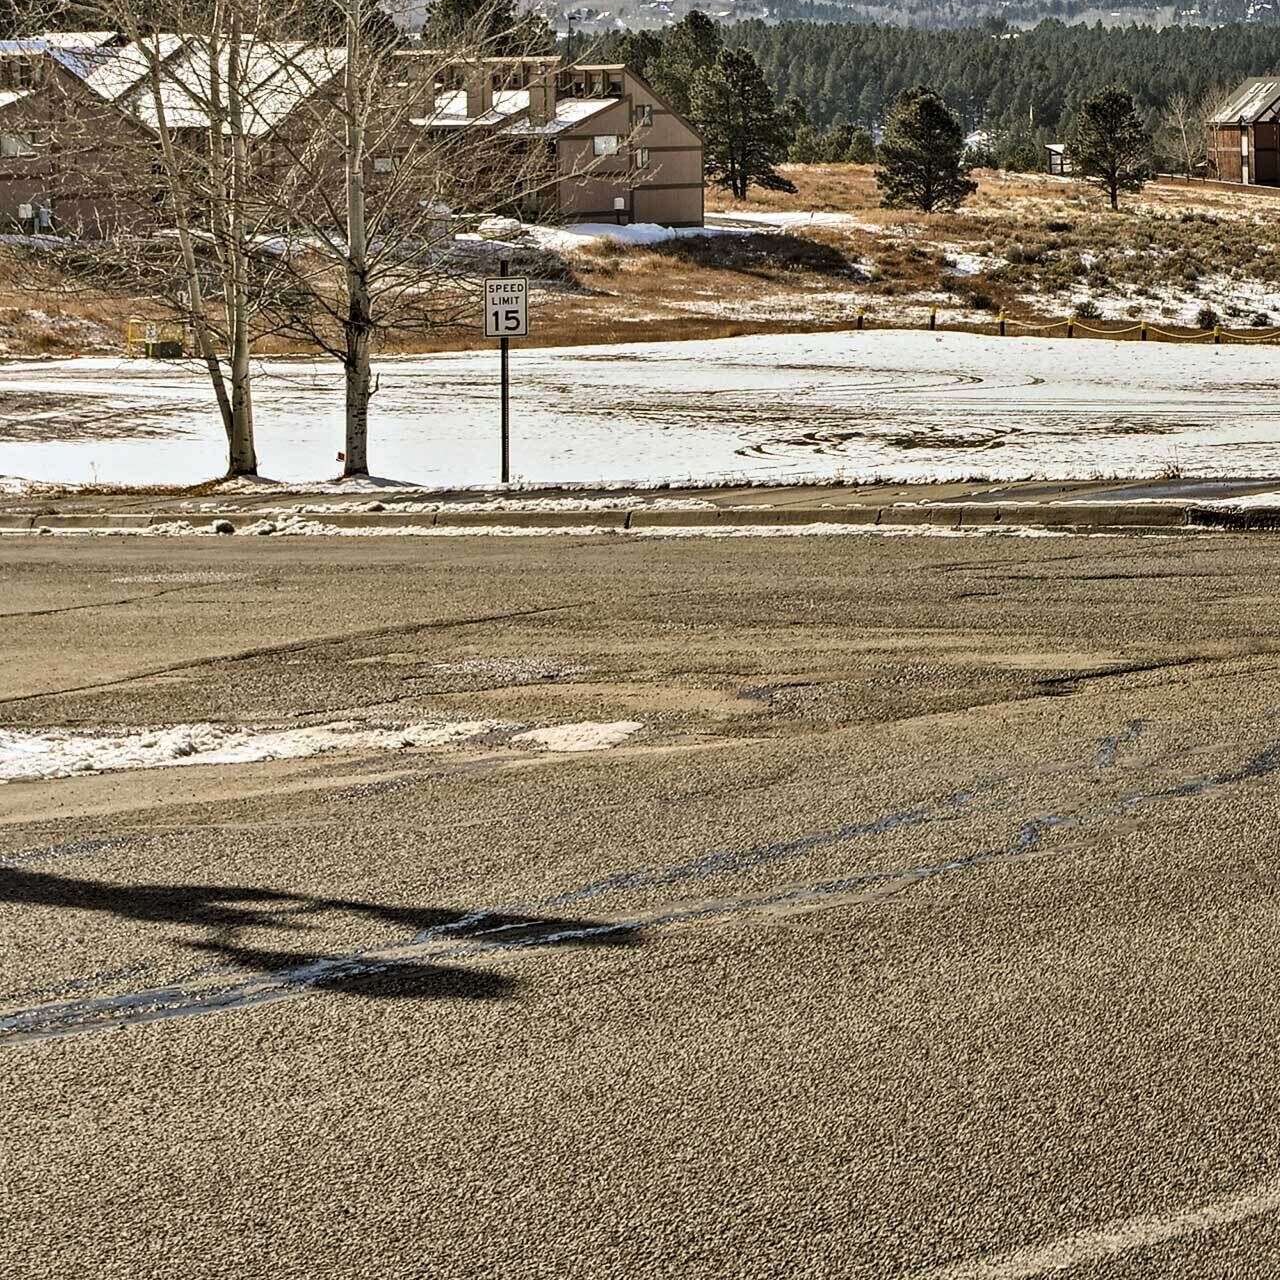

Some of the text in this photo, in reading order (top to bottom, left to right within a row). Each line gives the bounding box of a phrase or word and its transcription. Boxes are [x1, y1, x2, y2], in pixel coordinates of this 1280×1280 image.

[488, 284, 524, 293] SPEED
[491, 296, 520, 306] LIMIT
[492, 309, 520, 332] 15
